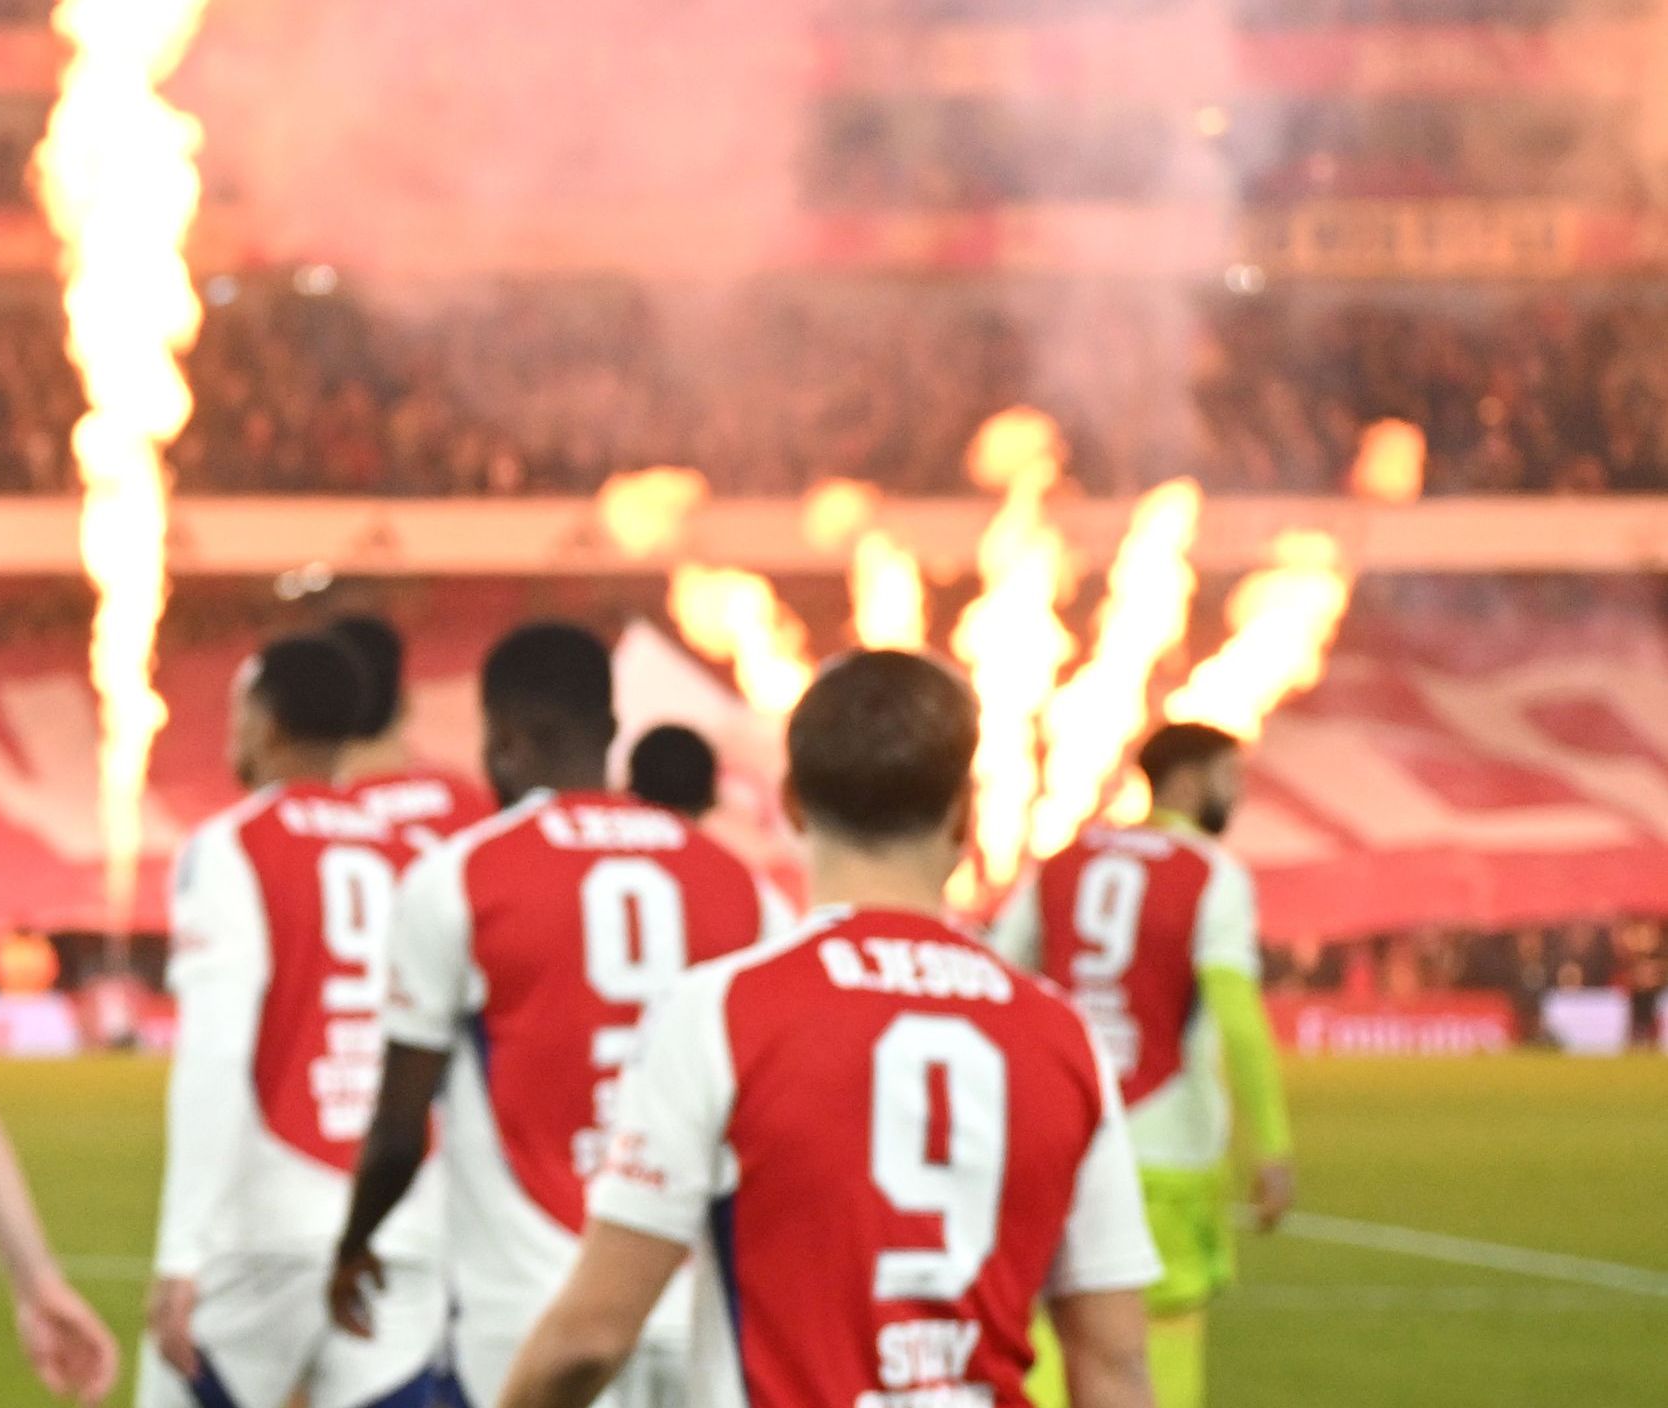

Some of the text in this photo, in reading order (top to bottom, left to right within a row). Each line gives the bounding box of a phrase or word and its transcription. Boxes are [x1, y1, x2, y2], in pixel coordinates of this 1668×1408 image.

[318, 842, 396, 1015] 9
[1070, 852, 1149, 984] 9
[870, 1012, 1008, 1301] 9
